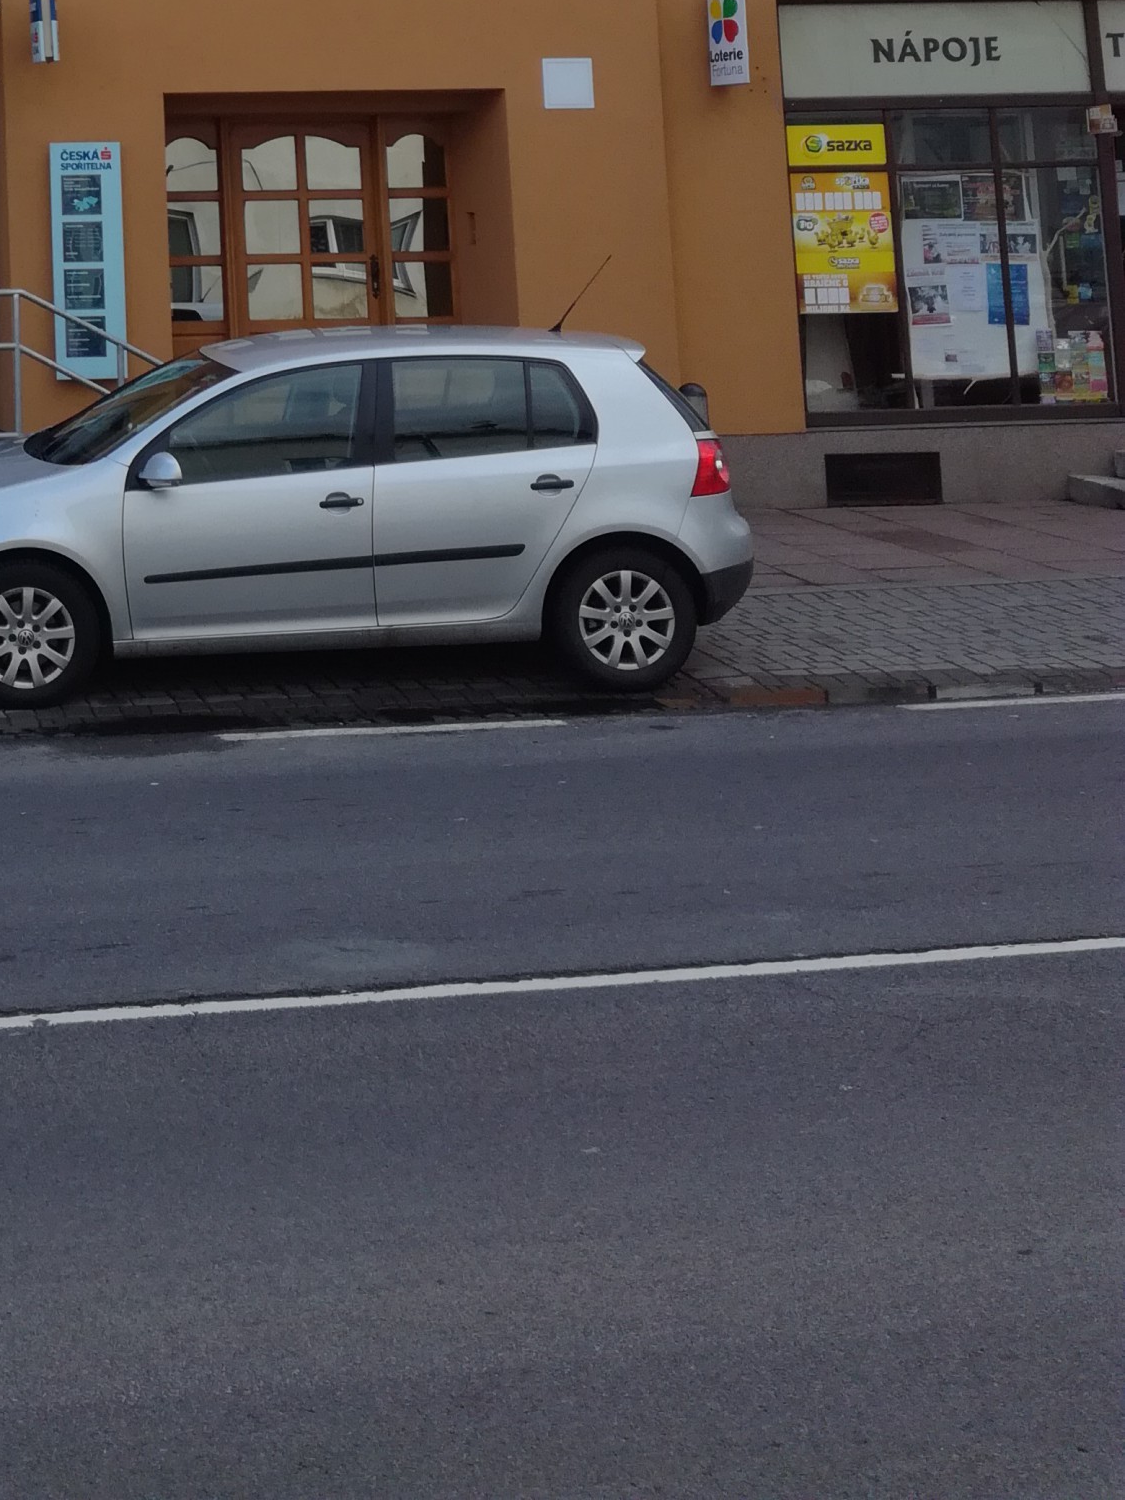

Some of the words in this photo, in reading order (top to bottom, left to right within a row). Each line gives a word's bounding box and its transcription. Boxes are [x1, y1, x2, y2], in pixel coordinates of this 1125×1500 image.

[710, 47, 743, 63] Loterie
[870, 30, 1001, 67] NÁPOJE
[712, 64, 743, 77] Fortuna
[60, 148, 100, 161] ČESKÁ
[60, 161, 112, 171] SPOŘITELNA
